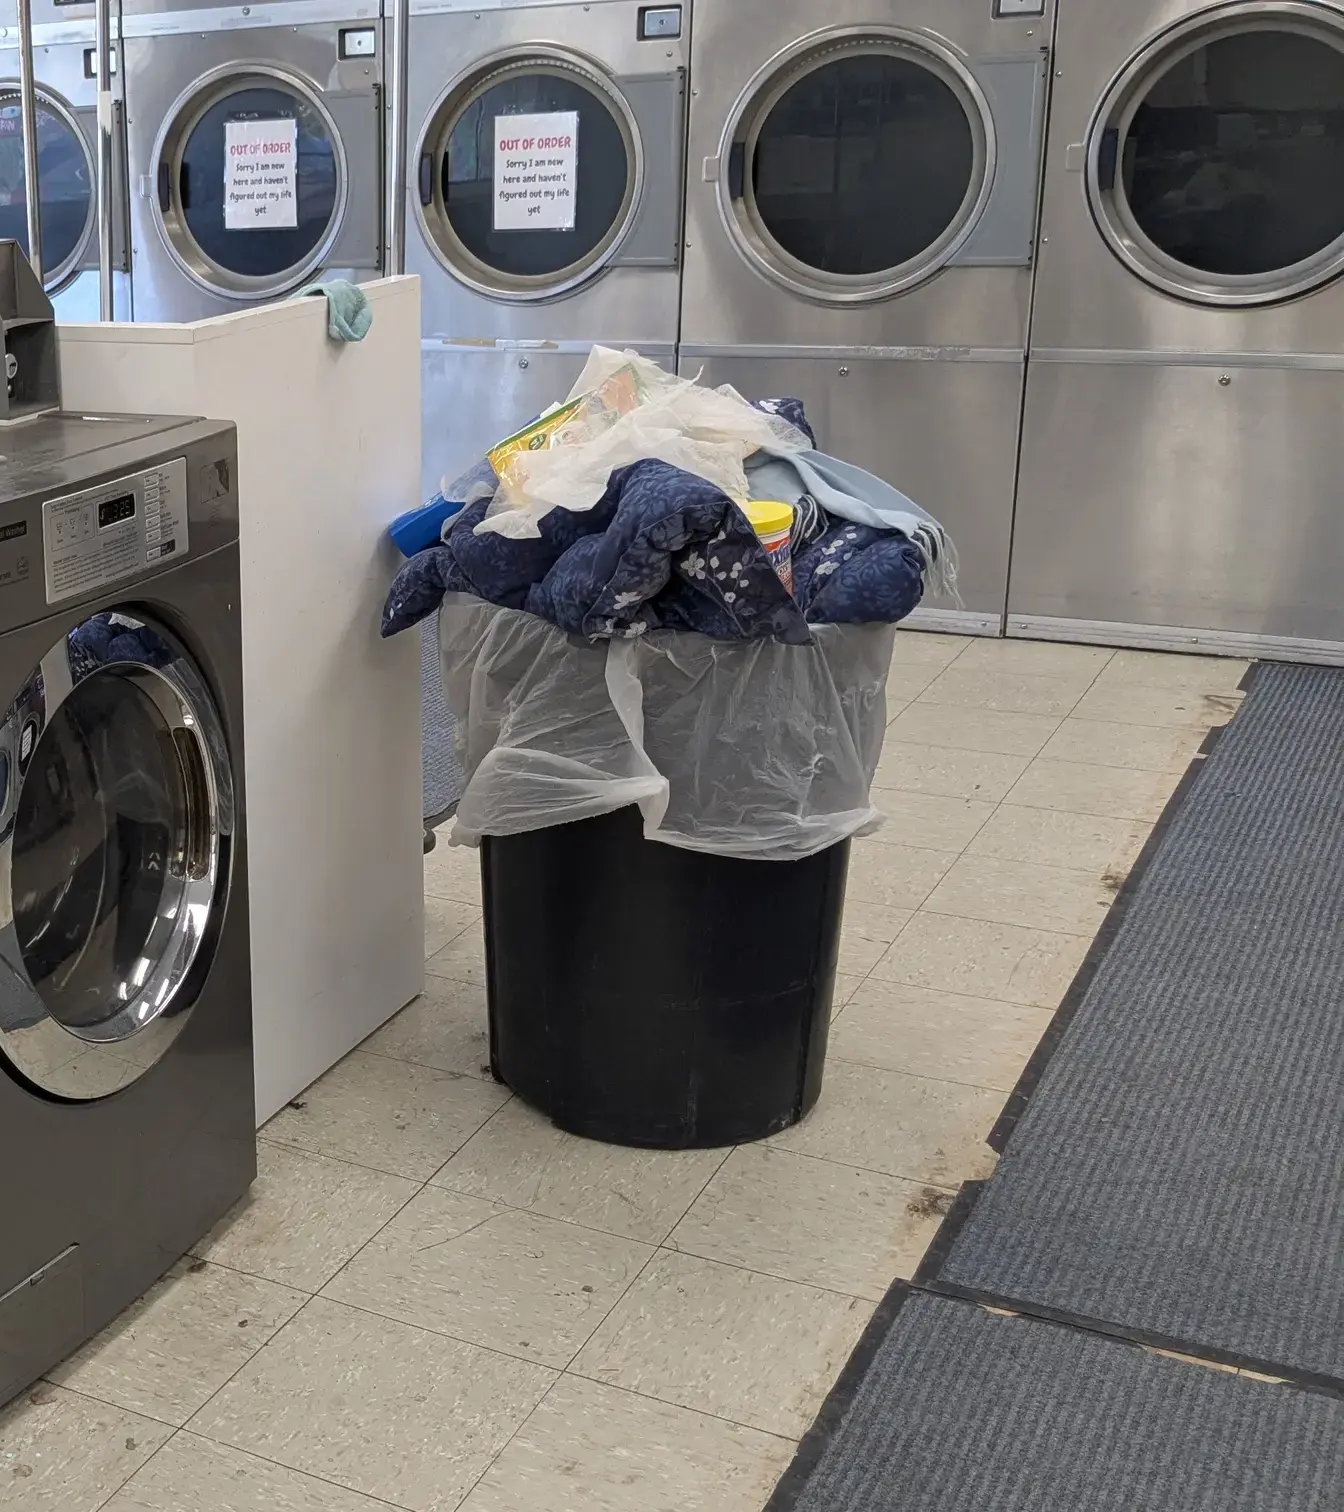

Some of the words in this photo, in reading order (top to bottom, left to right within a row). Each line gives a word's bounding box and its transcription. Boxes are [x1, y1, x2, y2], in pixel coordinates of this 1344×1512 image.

[230, 144, 248, 156] OUT
[250, 144, 260, 154] OF
[262, 142, 291, 154] ORDER
[500, 139, 520, 151] OUT
[522, 138, 535, 150] OF
[538, 136, 571, 149] ORDER
[236, 164, 254, 173] Sorry
[506, 159, 527, 170] Sorry
[233, 178, 248, 186] here
[250, 177, 262, 185] and
[264, 176, 288, 184] haven't
[503, 175, 520, 184] here
[523, 174, 536, 182] and
[538, 173, 567, 182] haven't
[230, 192, 254, 203] figured
[269, 192, 279, 201] my
[281, 190, 292, 198] life
[499, 190, 527, 202] figured
[529, 190, 542, 198] out
[544, 191, 555, 200] my
[557, 189, 570, 197] life
[255, 206, 266, 216] yet
[527, 205, 541, 216] yet
[5, 524, 26, 538] Washer
